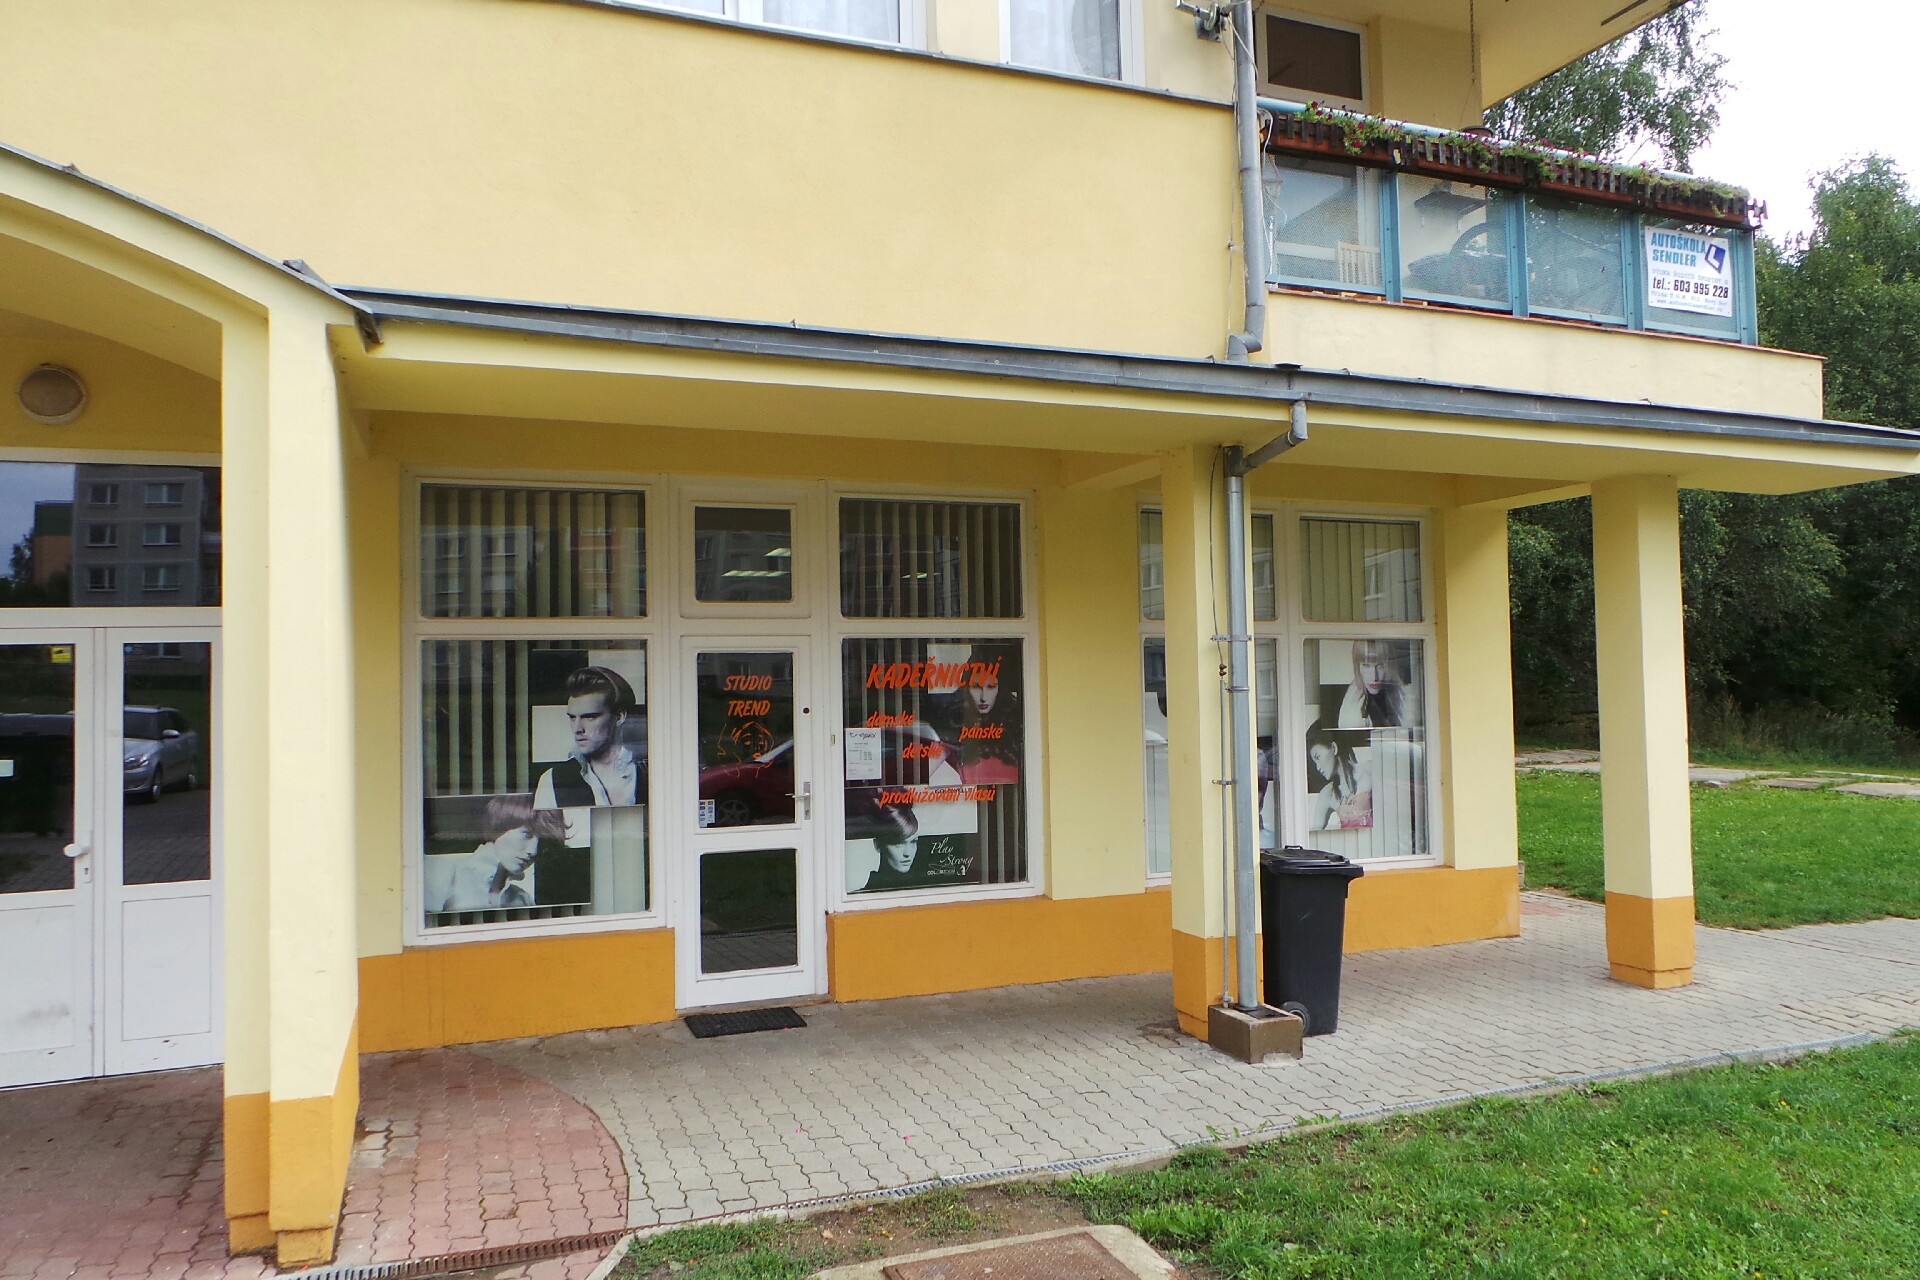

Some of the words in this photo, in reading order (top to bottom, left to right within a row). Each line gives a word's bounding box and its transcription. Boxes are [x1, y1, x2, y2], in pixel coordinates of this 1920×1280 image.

[1651, 232, 1706, 254] AUTOŠKOLA
[1652, 249, 1697, 267] SENDLER
[1652, 277, 1671, 291] tel.:
[1673, 279, 1691, 293] 603
[1693, 282, 1710, 296] 995
[1712, 285, 1729, 299] 228
[866, 656, 1002, 689] KADEŘNICTVÍ
[724, 675, 773, 691] STUDIO
[727, 700, 771, 717] TREND
[959, 723, 1004, 743] pánské
